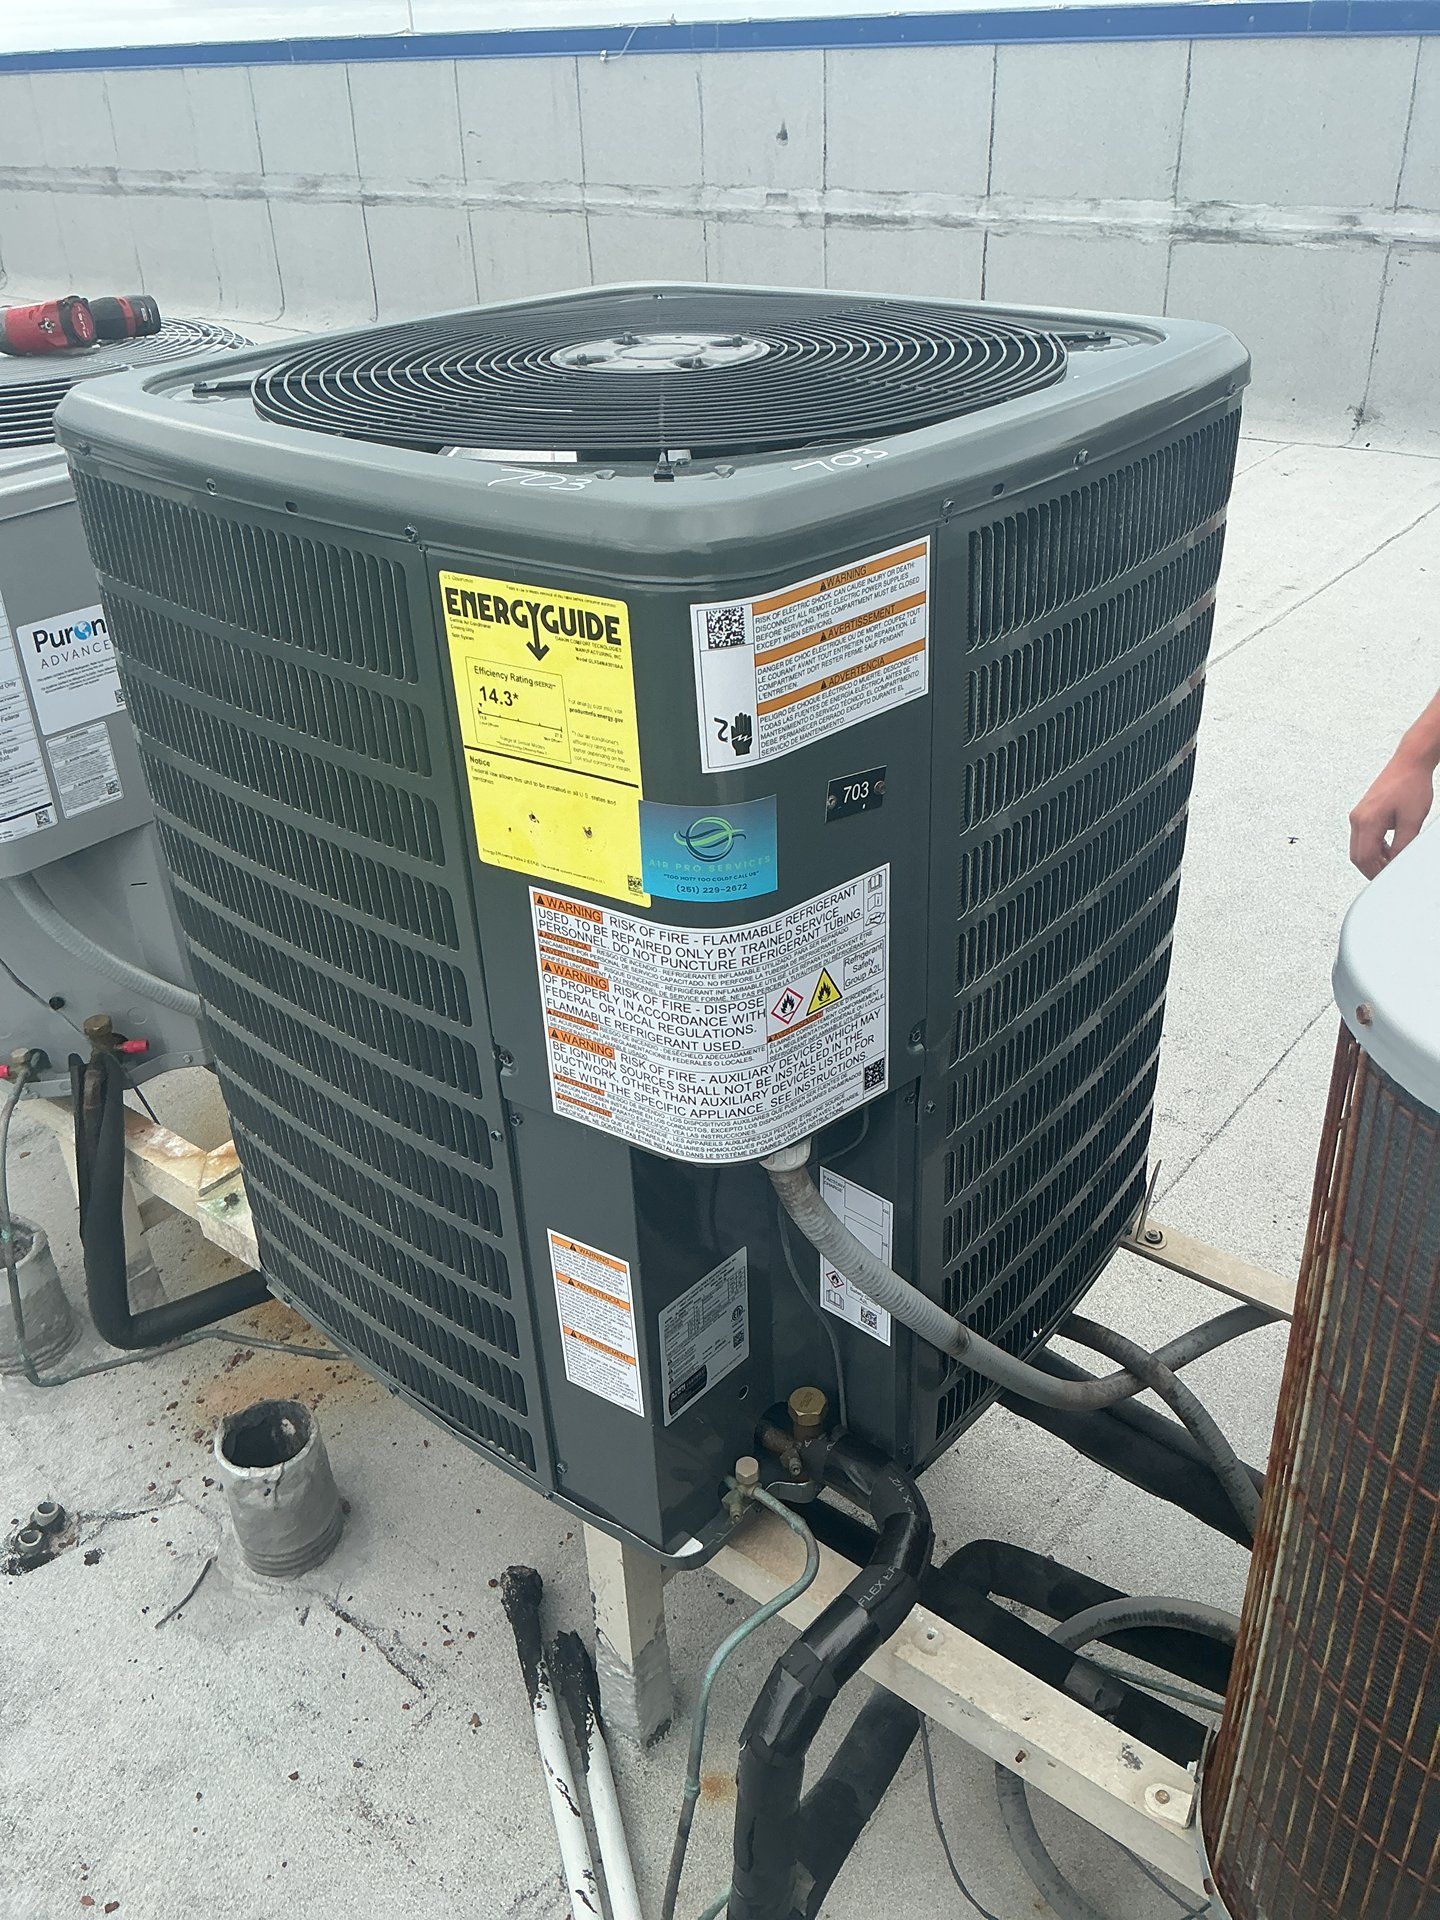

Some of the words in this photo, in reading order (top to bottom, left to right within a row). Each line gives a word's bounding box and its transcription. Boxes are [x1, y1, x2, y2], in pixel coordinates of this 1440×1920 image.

[793, 447, 889, 473] 703
[488, 468, 593, 490] 703
[826, 564, 866, 587] WARNING
[755, 614, 771, 624] RISK
[772, 610, 781, 620] OF
[782, 599, 810, 616] ELECTRIC
[833, 586, 845, 597] CAN
[846, 579, 865, 592] CAUSE
[867, 571, 886, 584] INJURY
[887, 568, 895, 577] OR
[755, 614, 795, 633] DISCONNECT
[797, 609, 806, 619] ALL
[808, 599, 831, 615] REMOTE
[833, 589, 859, 605] ELECTRIC
[862, 581, 882, 594] POWER
[883, 571, 908, 586] SUPPLIES
[756, 628, 781, 642] BEFORE
[817, 609, 829, 620] THIS
[831, 593, 872, 615] COMPARTMENT
[874, 587, 888, 598] MUST
[890, 584, 896, 592] BE
[898, 575, 919, 589] CLOSED
[444, 584, 621, 645] ENERGYGUIDE
[828, 604, 894, 638] AVERTISSEMENT
[32, 618, 106, 653] Puron
[756, 636, 781, 650] EXCEPT
[782, 629, 799, 642] WHEN
[42, 640, 111, 669] ADVANCE
[829, 654, 884, 688] ADVERTENCIA
[473, 665, 508, 681] Efficiency
[509, 672, 533, 686] Rating
[760, 719, 781, 731] TODAS
[783, 714, 792, 724] LAS
[794, 702, 819, 719] FUENTES
[821, 699, 828, 708] DE
[885, 668, 901, 680] ANTES
[903, 665, 909, 673] DE
[469, 755, 490, 766] Notice
[761, 741, 789, 756] SERVICIO
[790, 737, 798, 746] DE
[844, 782, 868, 803] 703
[649, 859, 668, 868] AIR
[676, 864, 700, 872] PRO
[708, 856, 770, 872] SERVICES
[547, 897, 600, 921] WARNING
[609, 915, 635, 933] RISK
[639, 925, 655, 938] OF
[659, 930, 689, 944] FIRE
[703, 919, 782, 945] FLAMMABLE
[785, 884, 856, 927] REFRIGERANT
[537, 907, 571, 926] USED.
[574, 918, 590, 932] TO
[593, 923, 608, 937] BE
[611, 928, 671, 955] REPAIRED
[675, 946, 713, 959] ONLY
[718, 947, 736, 958] BY
[740, 928, 792, 956] TRAINED
[795, 906, 838, 936] SERVICE
[538, 919, 609, 949] PERSONNEL.
[612, 941, 629, 955] DO
[632, 948, 656, 964] NOT
[660, 955, 736, 970] PUNCTURE
[741, 926, 820, 968] REFRIGERANT
[845, 939, 882, 968] Refrigerant
[853, 954, 874, 974] Safety
[554, 964, 606, 989] WARNING
[613, 983, 639, 1001] RISK
[642, 993, 658, 1006] OF
[662, 999, 691, 1012] FIRE
[704, 996, 763, 1013] DISPOSE
[845, 969, 866, 988] Group
[868, 963, 880, 976] A2L
[543, 973, 557, 985] OF
[561, 978, 620, 1007] PROPERLY
[623, 998, 633, 1010] IN
[637, 1003, 727, 1026] ACCORDANCE
[732, 1008, 765, 1024] WITH
[545, 984, 594, 1009] FEDERAL
[598, 1001, 615, 1016] OR
[618, 1008, 655, 1029] LOCAL
[658, 1021, 756, 1038] REGULATIONS.
[546, 997, 611, 1027] FLAMMABLE
[614, 1019, 698, 1050] REFRIGERANT
[703, 1039, 744, 1051] USED.
[552, 1040, 566, 1052] BE
[569, 1045, 616, 1071] IGNITION
[619, 1063, 673, 1090] SOURCES
[678, 1082, 719, 1095] SHALL
[724, 1081, 751, 1094] NOT
[756, 1075, 770, 1088] BE
[775, 1046, 829, 1082] INSTALLED
[832, 1039, 841, 1052] IN
[844, 1028, 862, 1047] THE
[561, 1031, 612, 1058] WARNING
[620, 1052, 645, 1070] RISK
[648, 1063, 664, 1076] OF
[668, 1069, 696, 1082] FIRE
[708, 1062, 776, 1083] AUXILIARY
[779, 1038, 822, 1068] DEVICES
[825, 1020, 857, 1045] WHICH
[860, 1007, 880, 1027] MAY
[553, 1050, 618, 1083] DUCTWORK,
[621, 1074, 659, 1096] OTHER
[663, 1089, 696, 1105] THAN
[700, 1087, 768, 1106] AUXILIARY
[771, 1064, 815, 1094] DEVICES
[818, 1044, 851, 1071] LISTED
[855, 1031, 874, 1053] FOR
[554, 1063, 576, 1078] USE
[578, 1071, 606, 1089] WITH
[609, 1081, 630, 1098] THE
[633, 1091, 685, 1116] SPECIFIC
[689, 1101, 766, 1118] APPLIANCE.
[770, 1090, 791, 1108] SEE
[858, 1580, 886, 1608] FLEX
